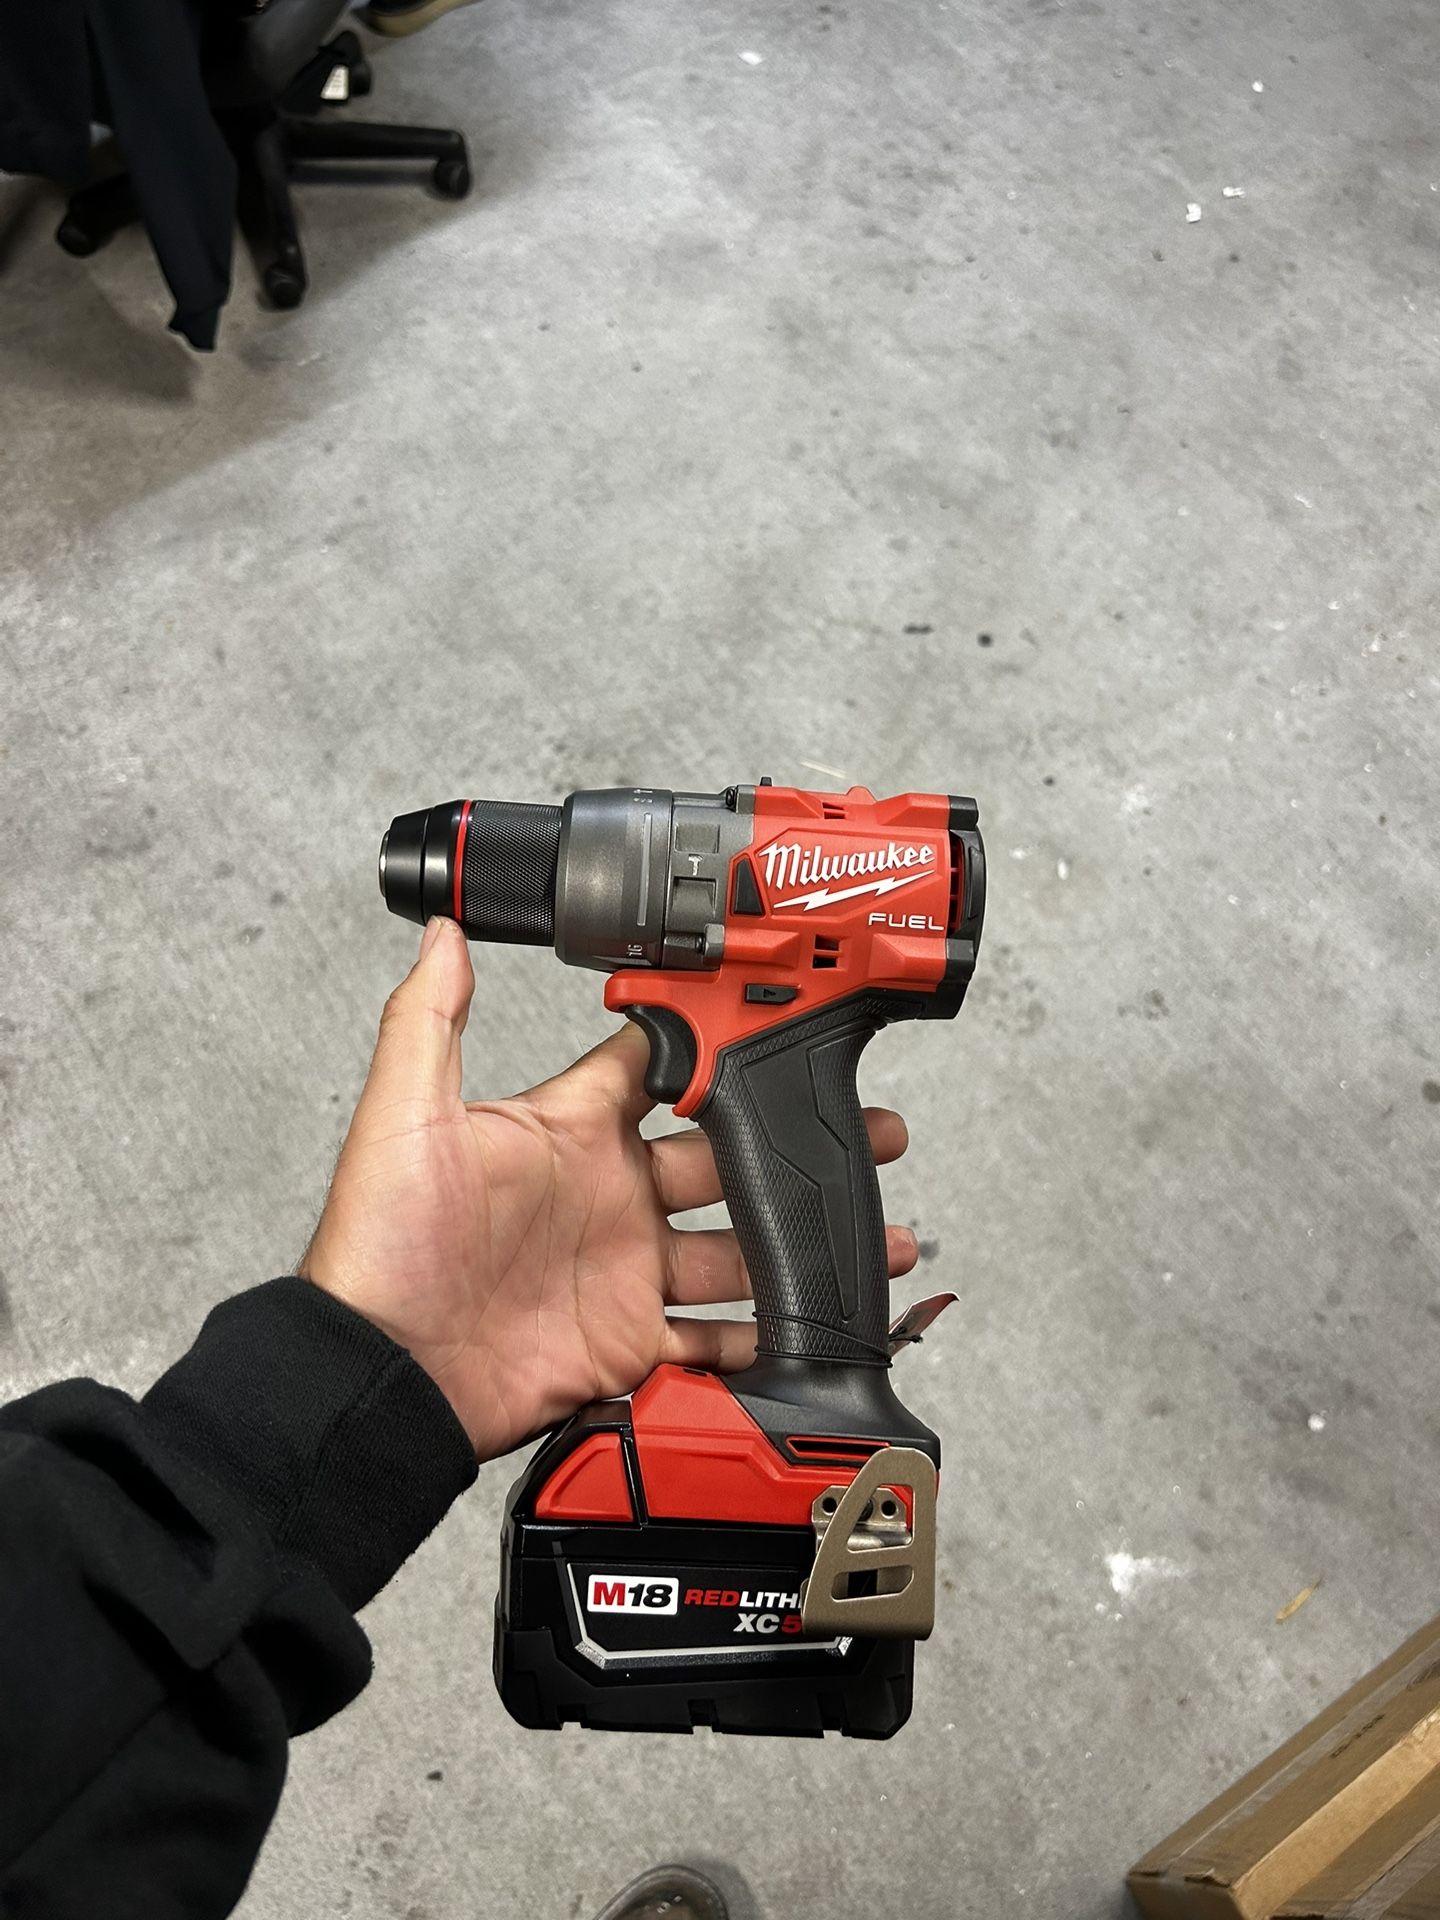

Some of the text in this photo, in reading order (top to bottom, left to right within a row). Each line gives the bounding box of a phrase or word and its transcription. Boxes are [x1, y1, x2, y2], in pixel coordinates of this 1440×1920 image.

[758, 842, 936, 890] Milwaukee
[868, 913, 945, 931] FUEL
[627, 944, 643, 956] 16
[593, 1581, 801, 1609] M18 REDLITH
